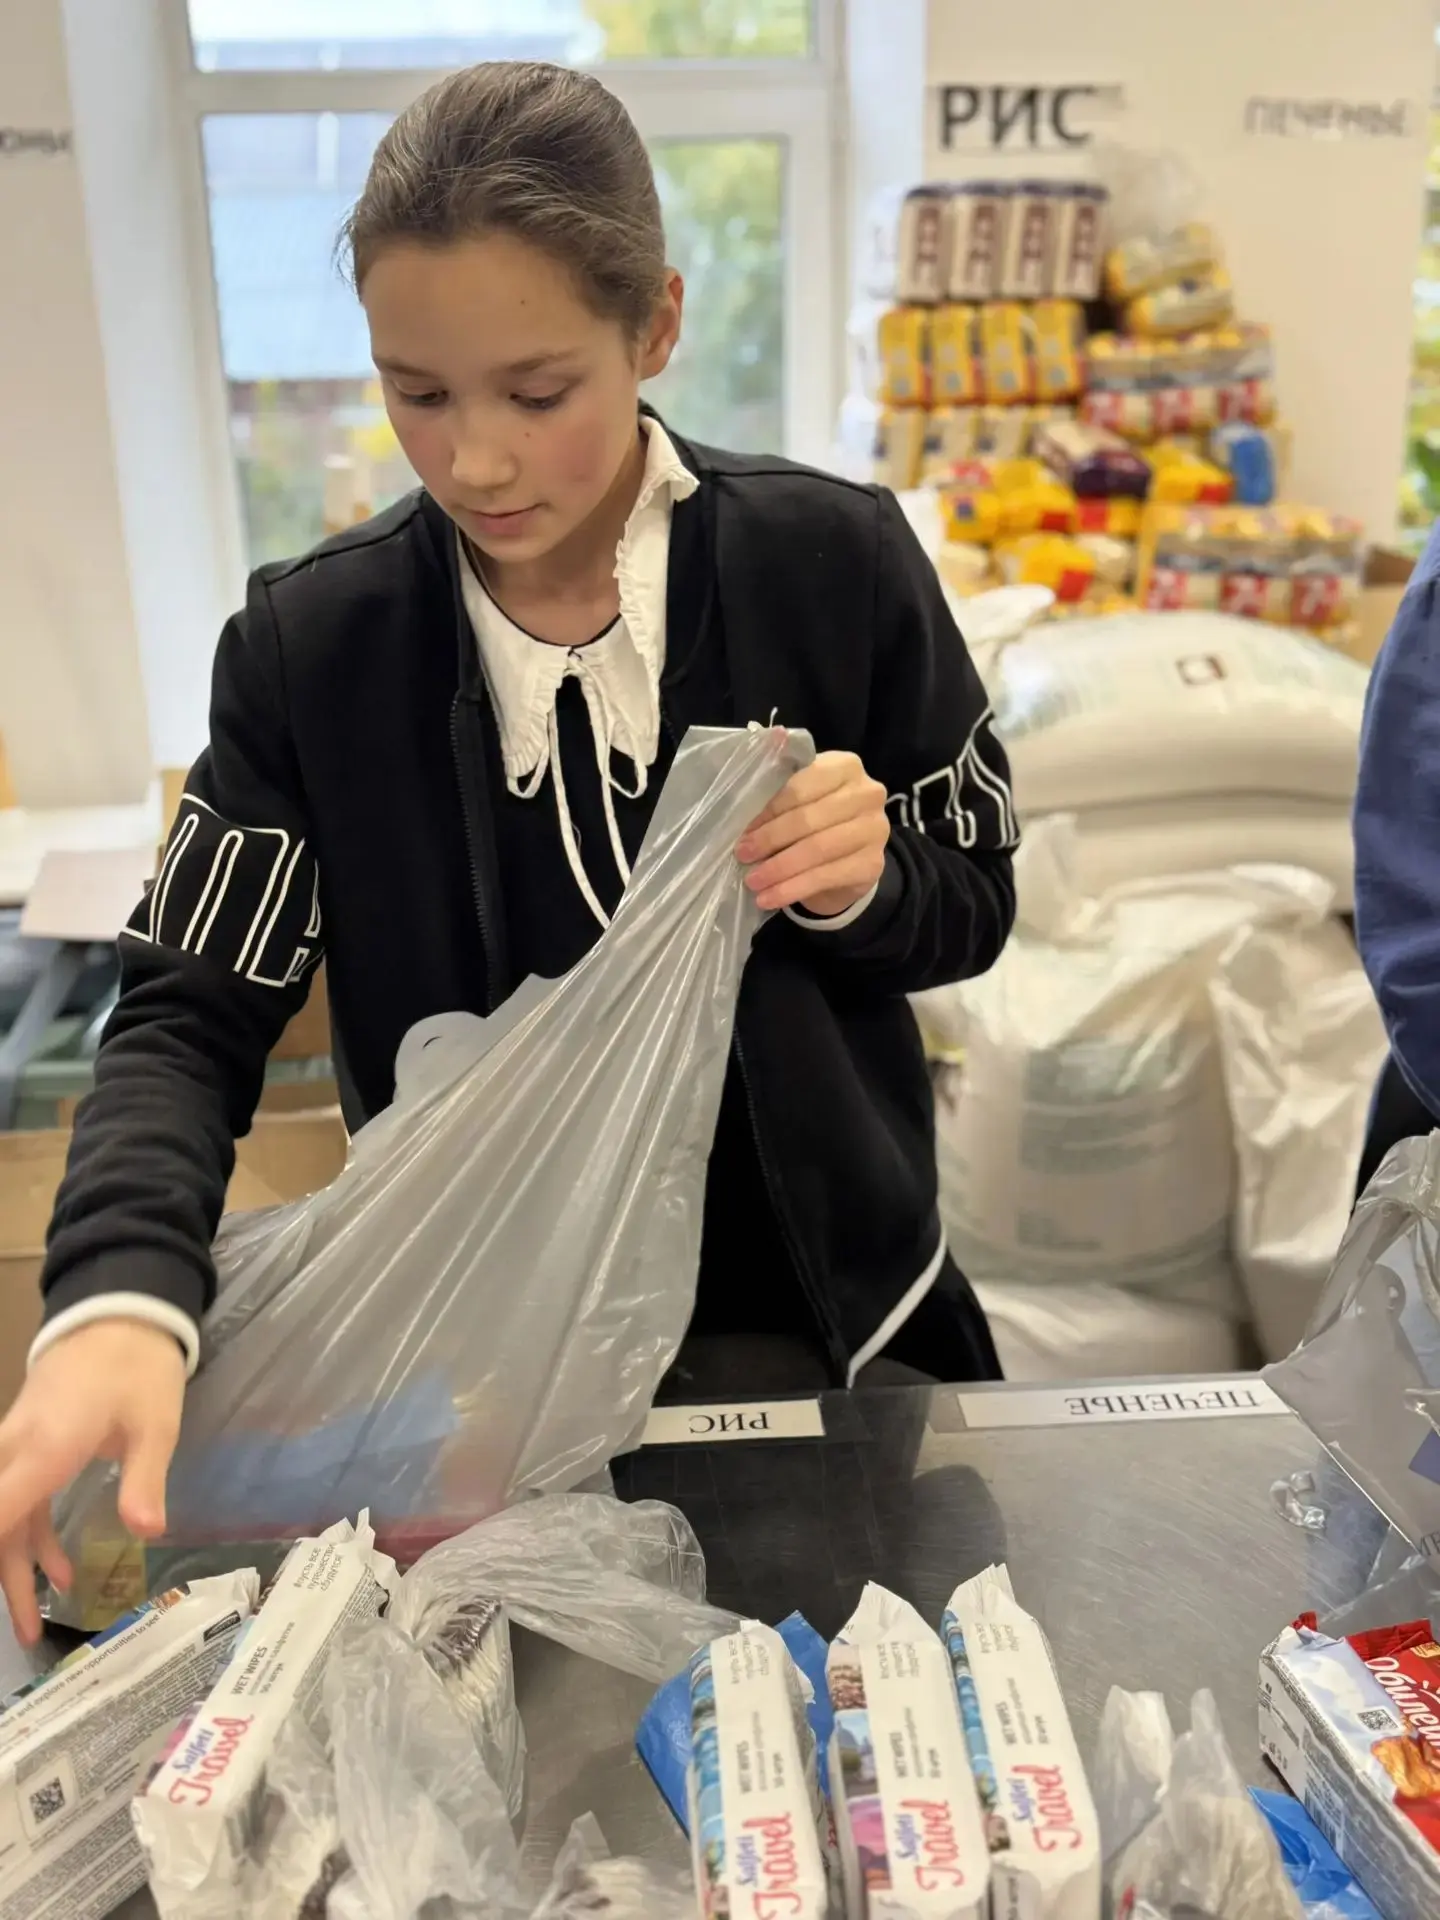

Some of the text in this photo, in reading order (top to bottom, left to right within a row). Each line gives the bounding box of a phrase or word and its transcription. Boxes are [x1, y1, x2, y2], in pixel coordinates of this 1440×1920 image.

[937, 84, 1097, 150] РИС
[688, 1411, 771, 1434] РИС
[1065, 1390, 1261, 1415] ПЕЧЕНЬЕ
[33, 1681, 65, 1707] explore
[65, 1668, 83, 1683] new
[83, 1632, 136, 1671] opportunities
[134, 1624, 146, 1635] to
[145, 1614, 161, 1628] see
[231, 1674, 249, 1695] WET
[245, 1645, 267, 1674] WIPES
[168, 1714, 255, 1806] Travel
[899, 1799, 965, 1891] Travel
[1011, 1764, 1082, 1852] Travel
[741, 1811, 802, 1920] Travel
